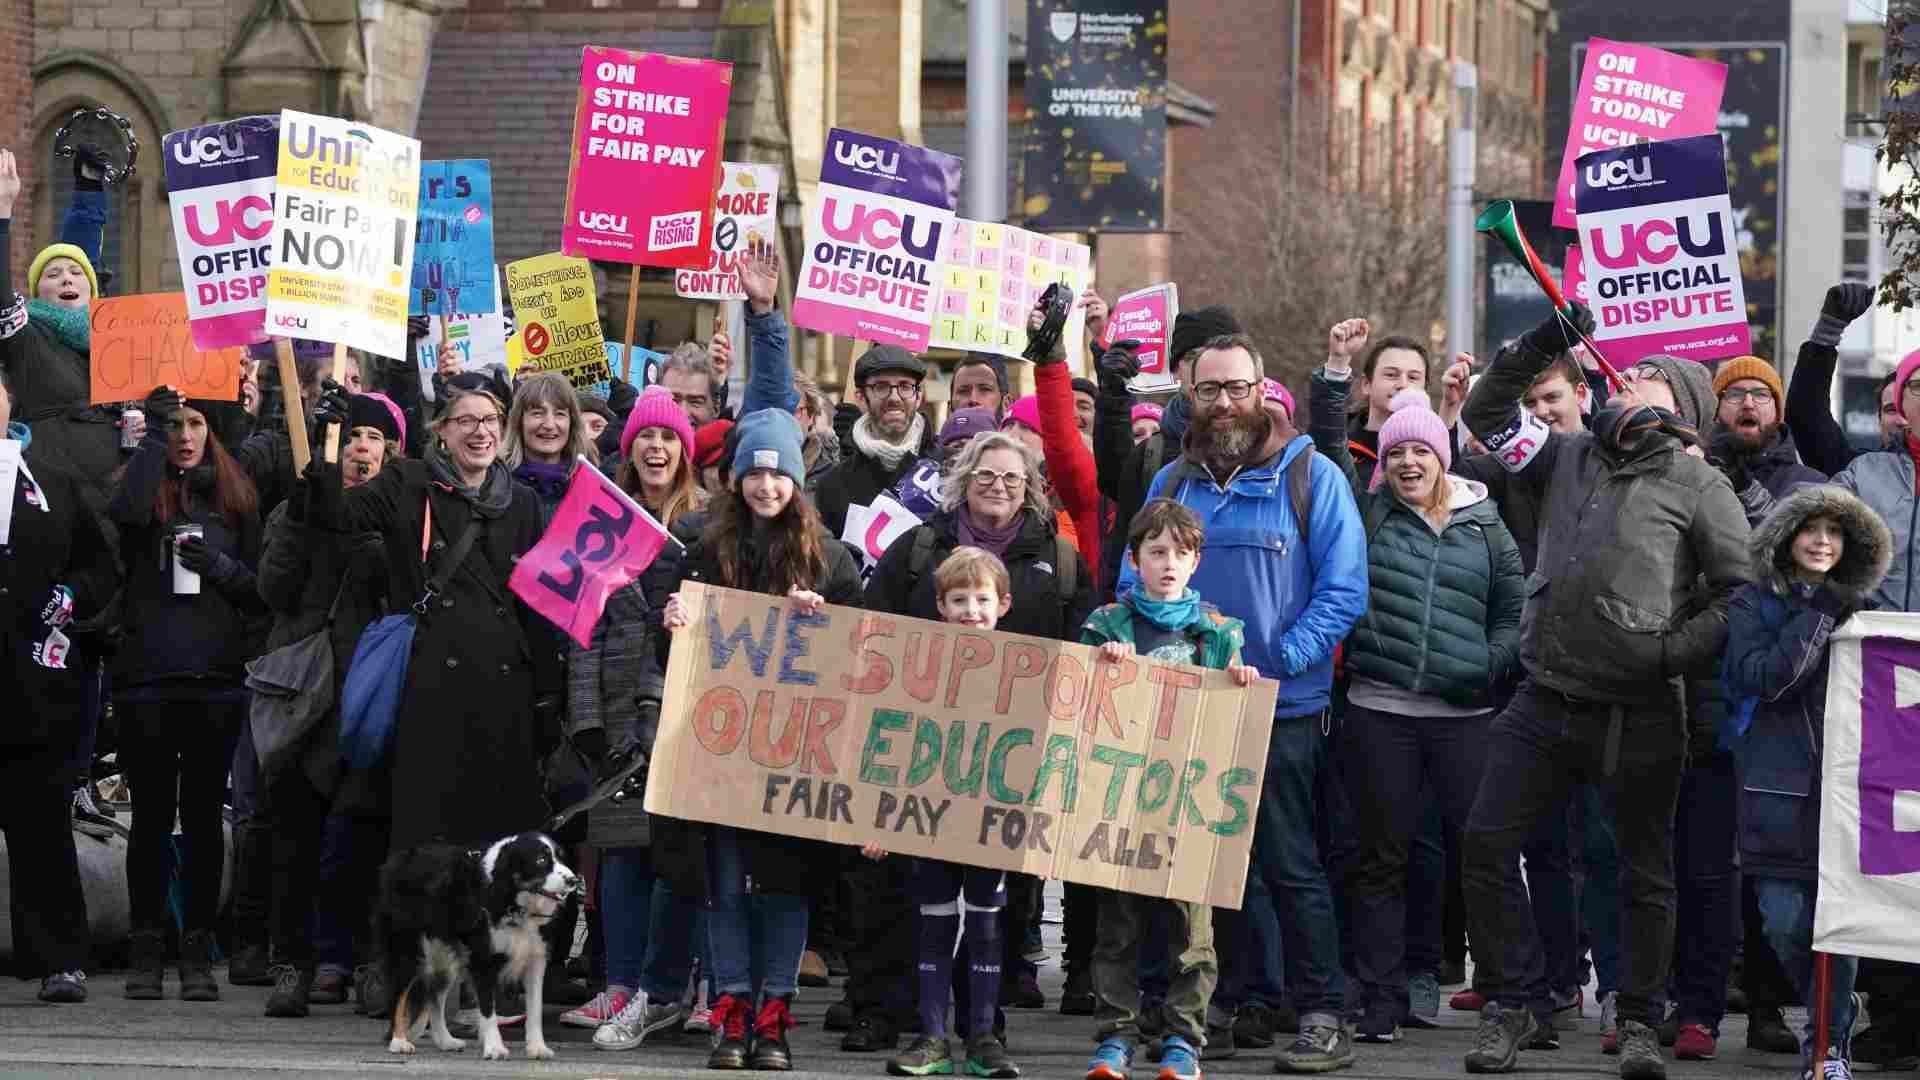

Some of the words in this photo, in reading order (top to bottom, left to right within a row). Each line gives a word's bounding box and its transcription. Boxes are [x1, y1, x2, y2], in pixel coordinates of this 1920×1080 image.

[597, 62, 637, 85] ON
[1598, 53, 1637, 75] ON
[593, 87, 690, 117] STRIKE
[1052, 88, 1138, 102] UNIVERSITY
[1593, 75, 1686, 111] STRIKE
[591, 112, 645, 137] FOR
[1048, 104, 1070, 117] OF
[1072, 104, 1102, 117] THE
[1103, 104, 1143, 119] YEAR
[1590, 96, 1675, 129] TODAY
[174, 133, 245, 165] UCU
[1583, 124, 1637, 147] UCU
[588, 136, 650, 162] FAIR
[653, 145, 705, 168] PAY
[834, 141, 900, 175] UCU
[1586, 156, 1653, 188] UCU
[184, 193, 276, 246] UC
[285, 195, 336, 224] Fair
[580, 211, 628, 232] UCU
[656, 217, 696, 228] UCU
[655, 226, 694, 246] RISING
[822, 198, 942, 262] UCU
[1590, 211, 1726, 270] UCU
[193, 245, 272, 277] OFFIC
[814, 242, 931, 287] OFFICIAL
[198, 275, 266, 305] DISP
[560, 285, 585, 303] ADD
[808, 266, 930, 313] DISPUTE
[1598, 263, 1731, 299] OFFICIAL
[274, 314, 308, 329] UCU
[1602, 290, 1735, 328] DISPUTE
[537, 486, 635, 604] UCU
[705, 605, 831, 687] WE
[840, 616, 1201, 741] SUPPORT
[692, 686, 846, 775] OUR
[858, 708, 1256, 836] EDUCATORS
[762, 775, 853, 824] FAIR
[875, 791, 951, 838] PAY
[979, 806, 1052, 854] FOR
[1078, 822, 1176, 870] ALL!
